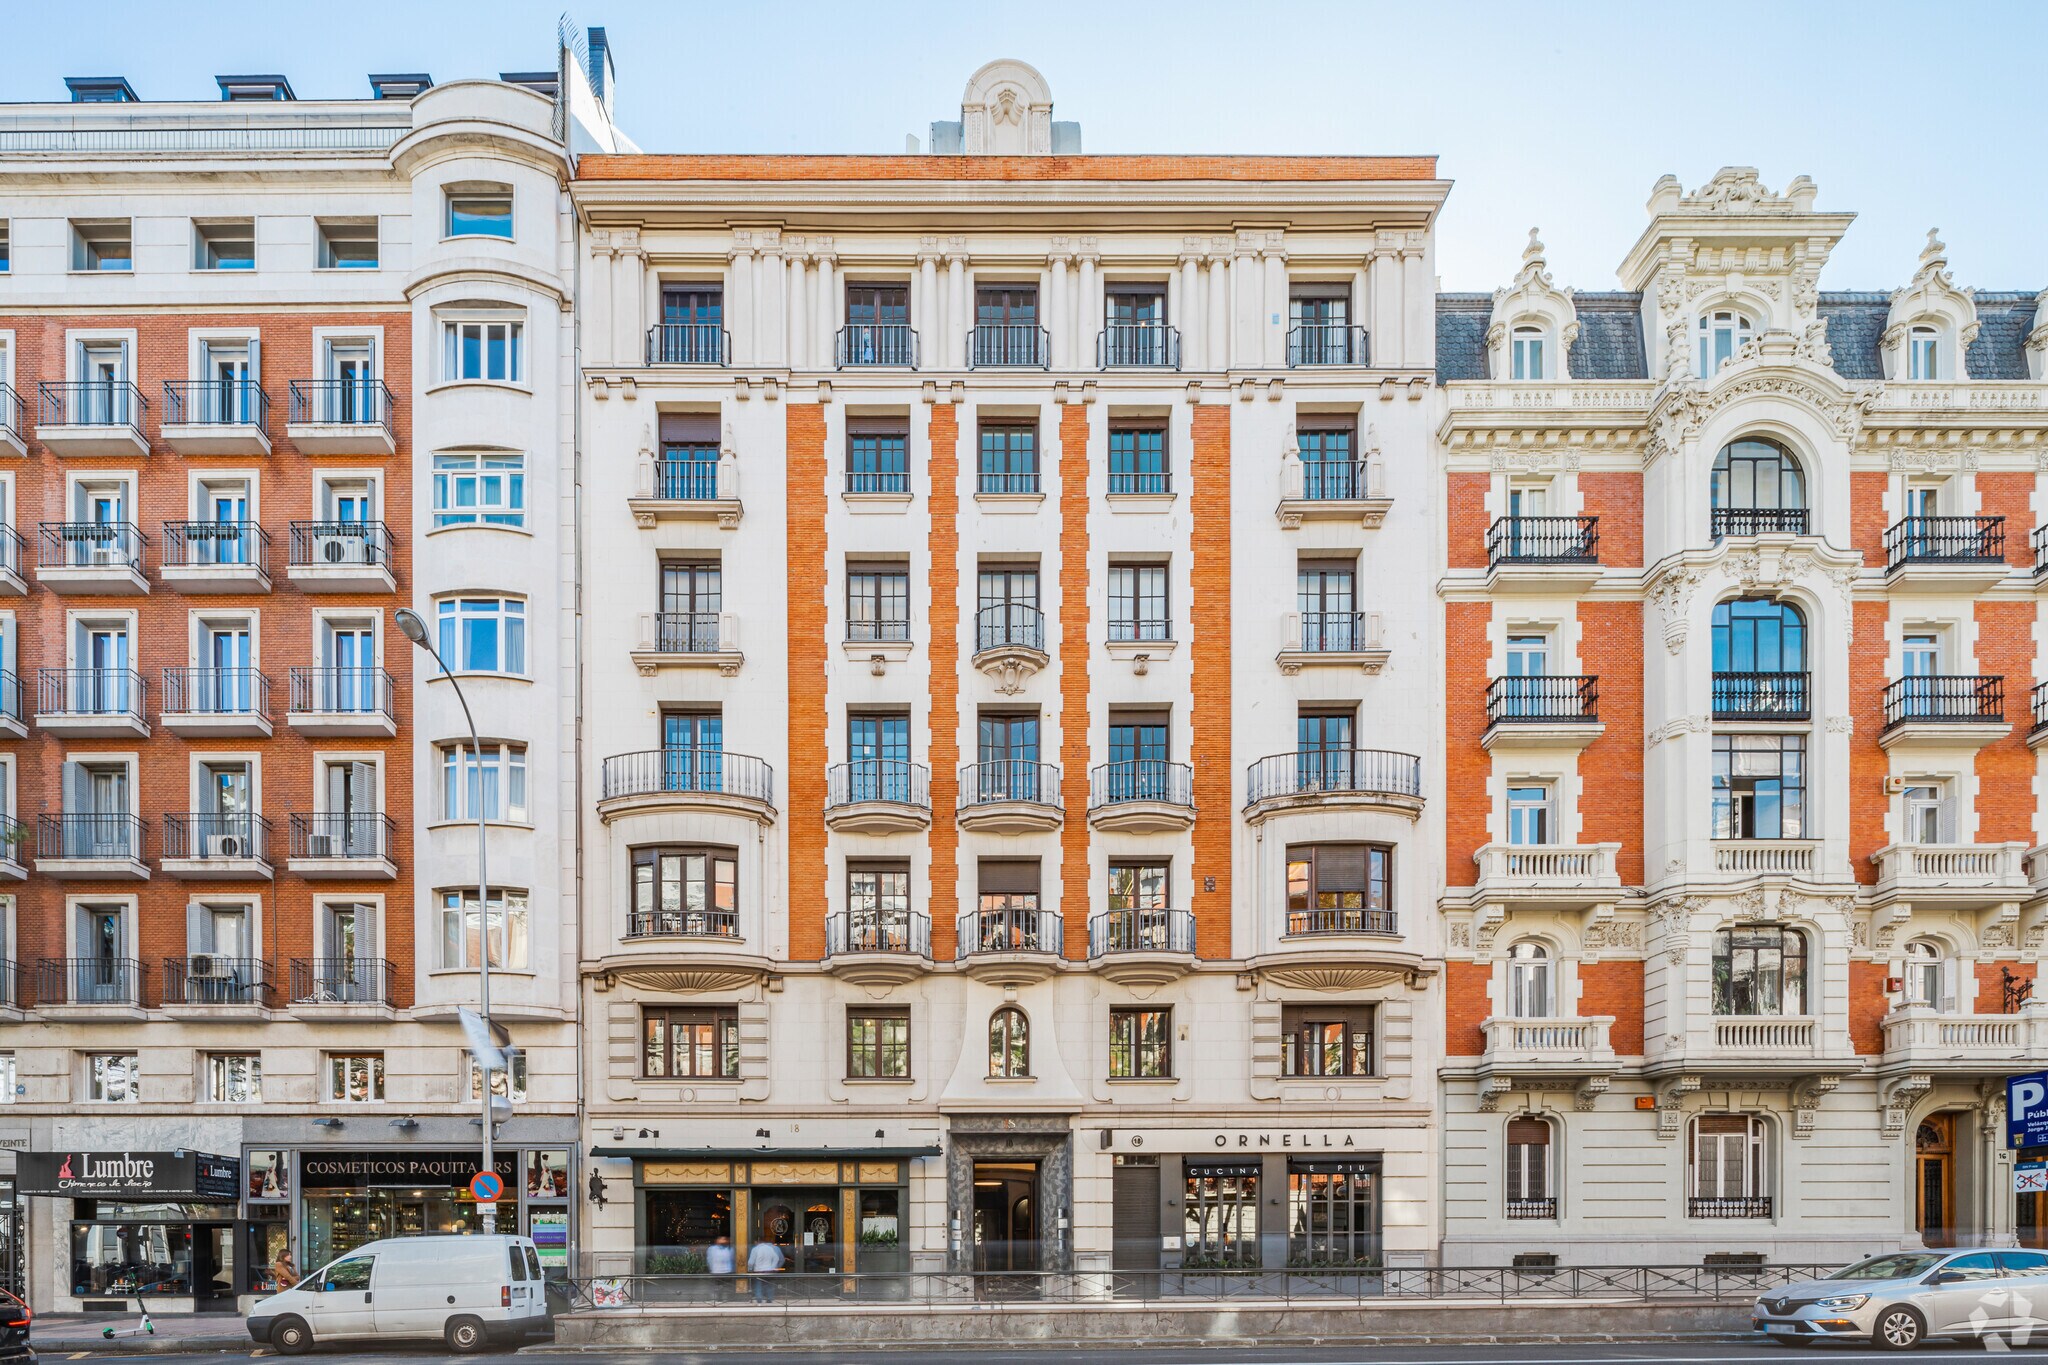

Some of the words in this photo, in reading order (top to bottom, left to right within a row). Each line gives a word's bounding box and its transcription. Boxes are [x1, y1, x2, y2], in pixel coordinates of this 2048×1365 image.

[2012, 1082, 2044, 1121] P
[790, 1124, 800, 1133] 18
[1214, 1134, 1355, 1147] ORNELLA
[82, 1152, 154, 1178] Lumbre
[210, 1165, 232, 1178] Lumbre
[306, 1162, 405, 1174] COSMETICOS
[410, 1162, 478, 1177] PAQUITA
[489, 1161, 512, 1174] RS
[261, 1281, 277, 1291] Lum
